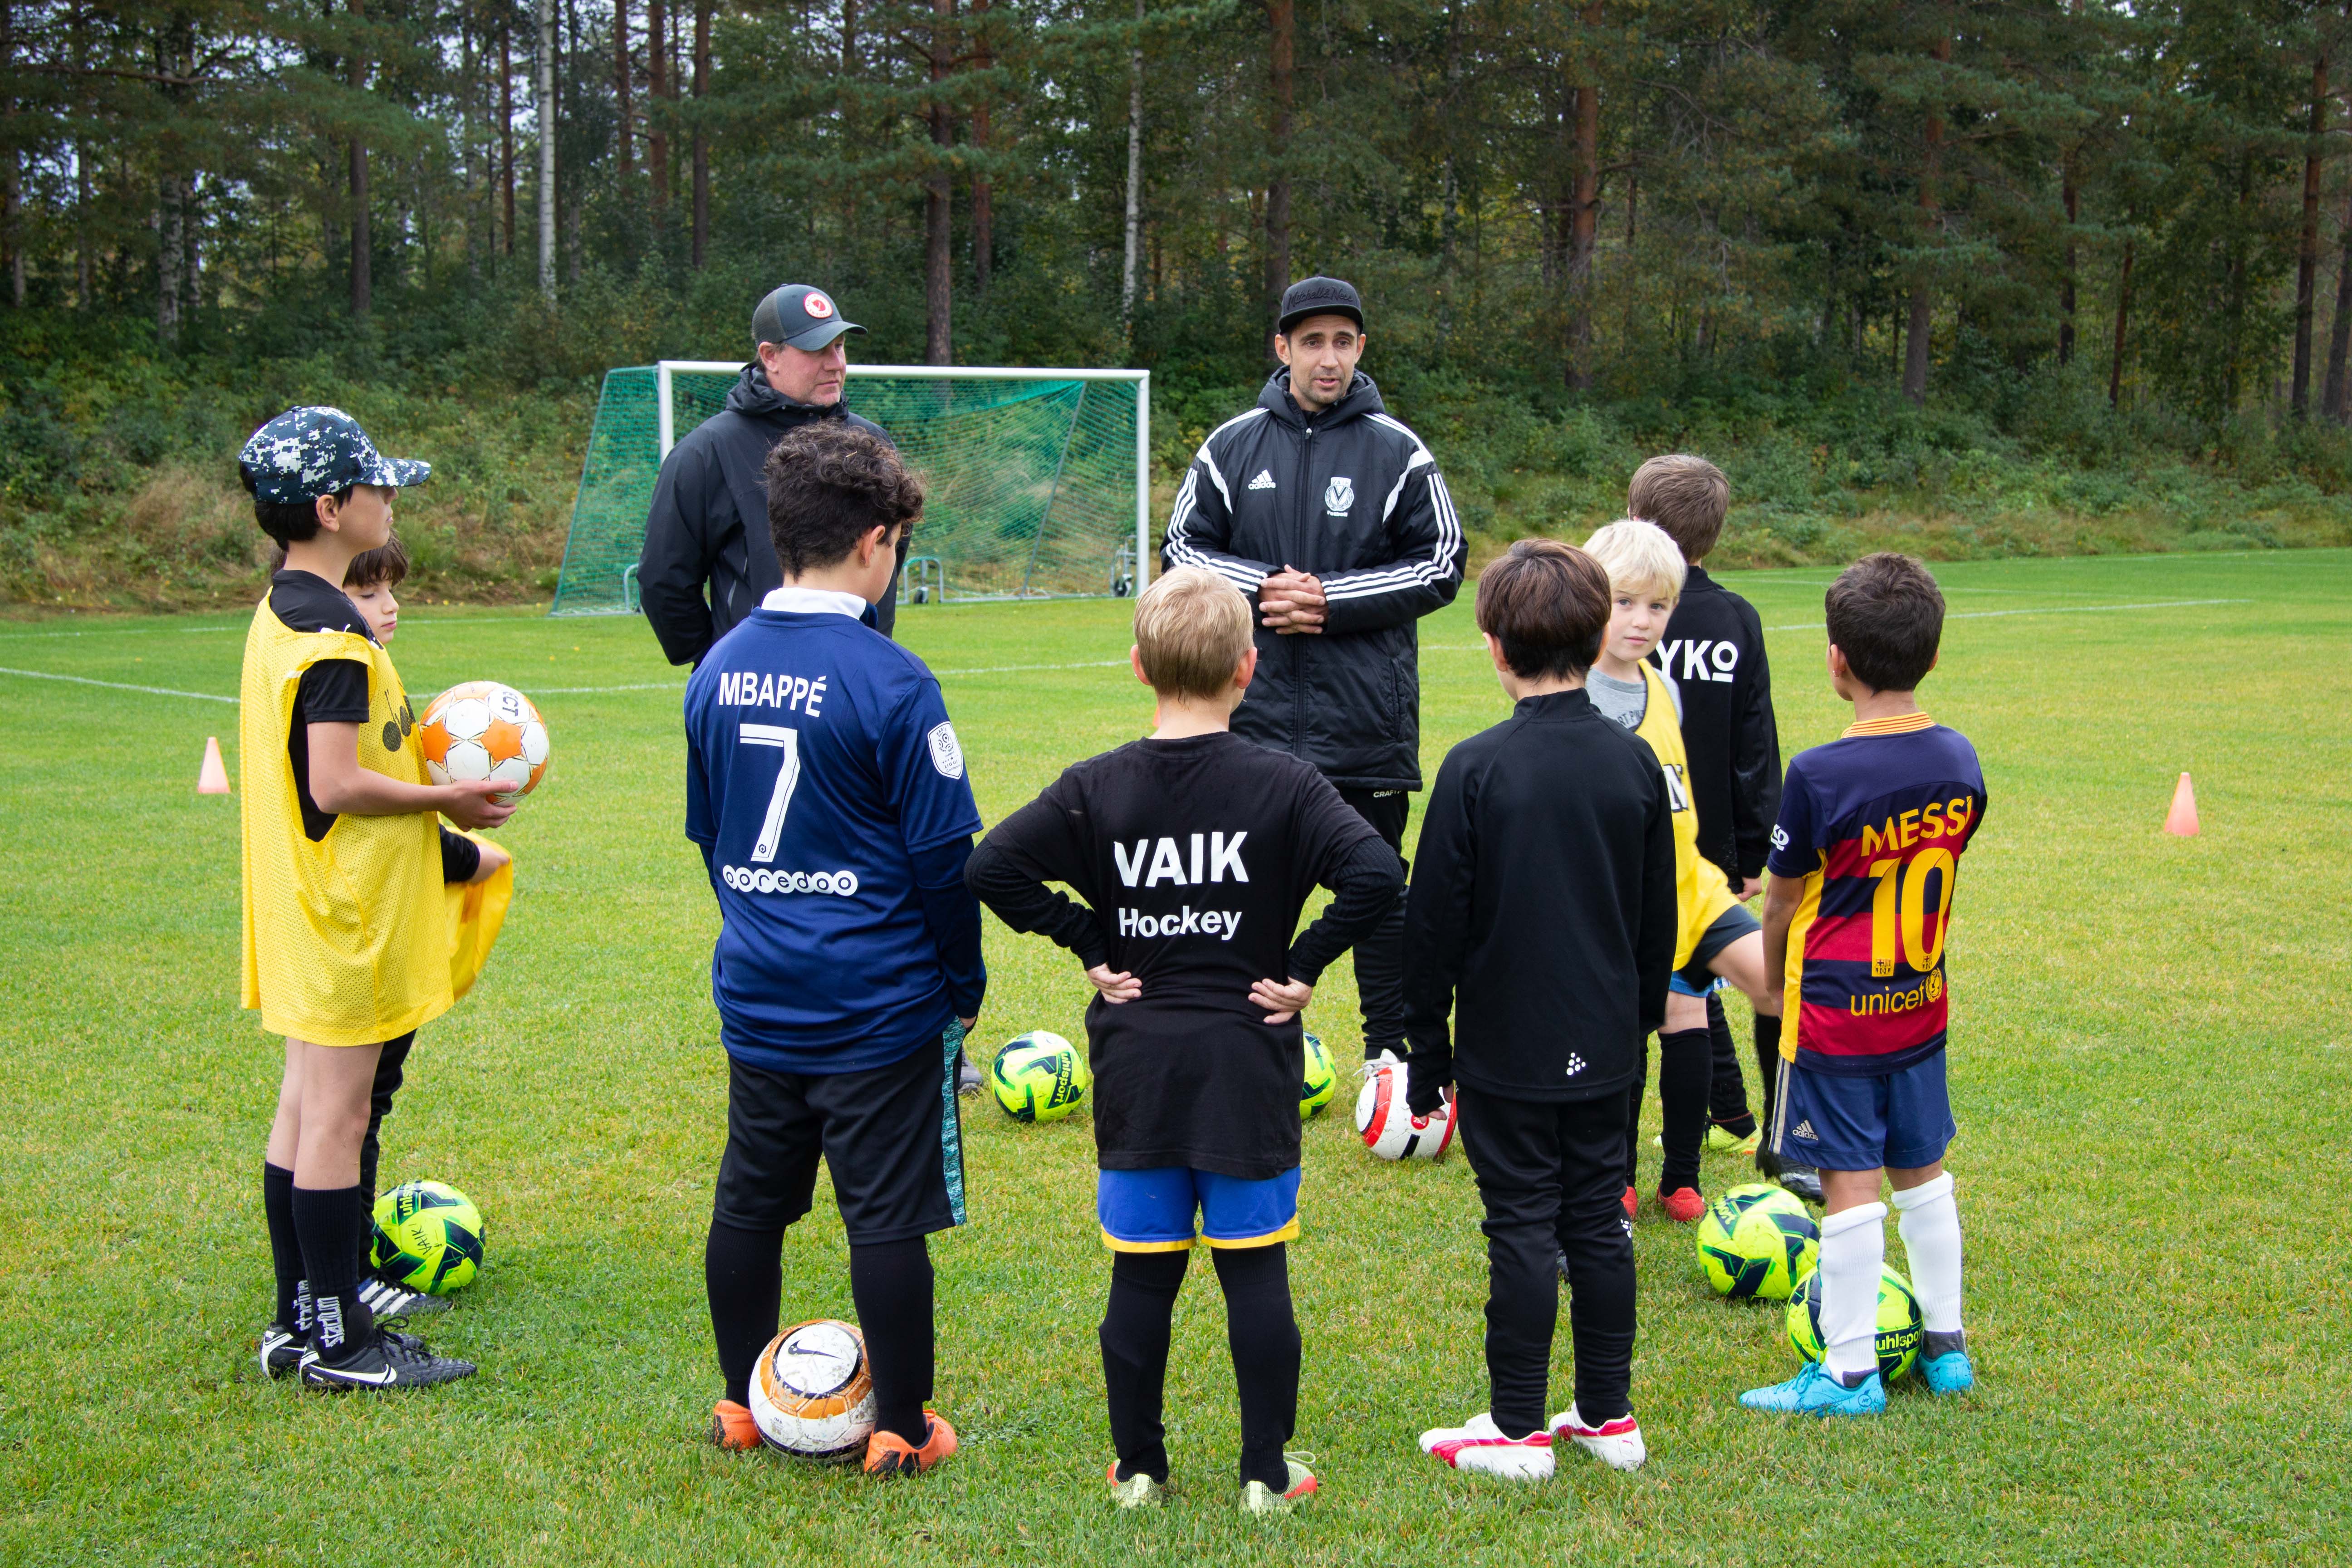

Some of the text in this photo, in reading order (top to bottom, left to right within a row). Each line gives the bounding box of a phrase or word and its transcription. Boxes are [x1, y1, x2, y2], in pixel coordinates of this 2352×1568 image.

[1287, 287, 1324, 310] Mitchell
[1248, 481, 1276, 490] adidas
[719, 672, 827, 718] MBAPPÉ
[740, 723, 801, 862] 7
[1861, 796, 1972, 857] MESSI
[745, 865, 881, 896] ooredoo
[1114, 832, 1249, 887] VAIK
[1118, 906, 1242, 941] Hockey
[1869, 847, 1955, 977] 10
[1851, 979, 1925, 1017] unicef
[1054, 1053, 1071, 1103] uhlsport
[1793, 1129, 1818, 1141] adidas
